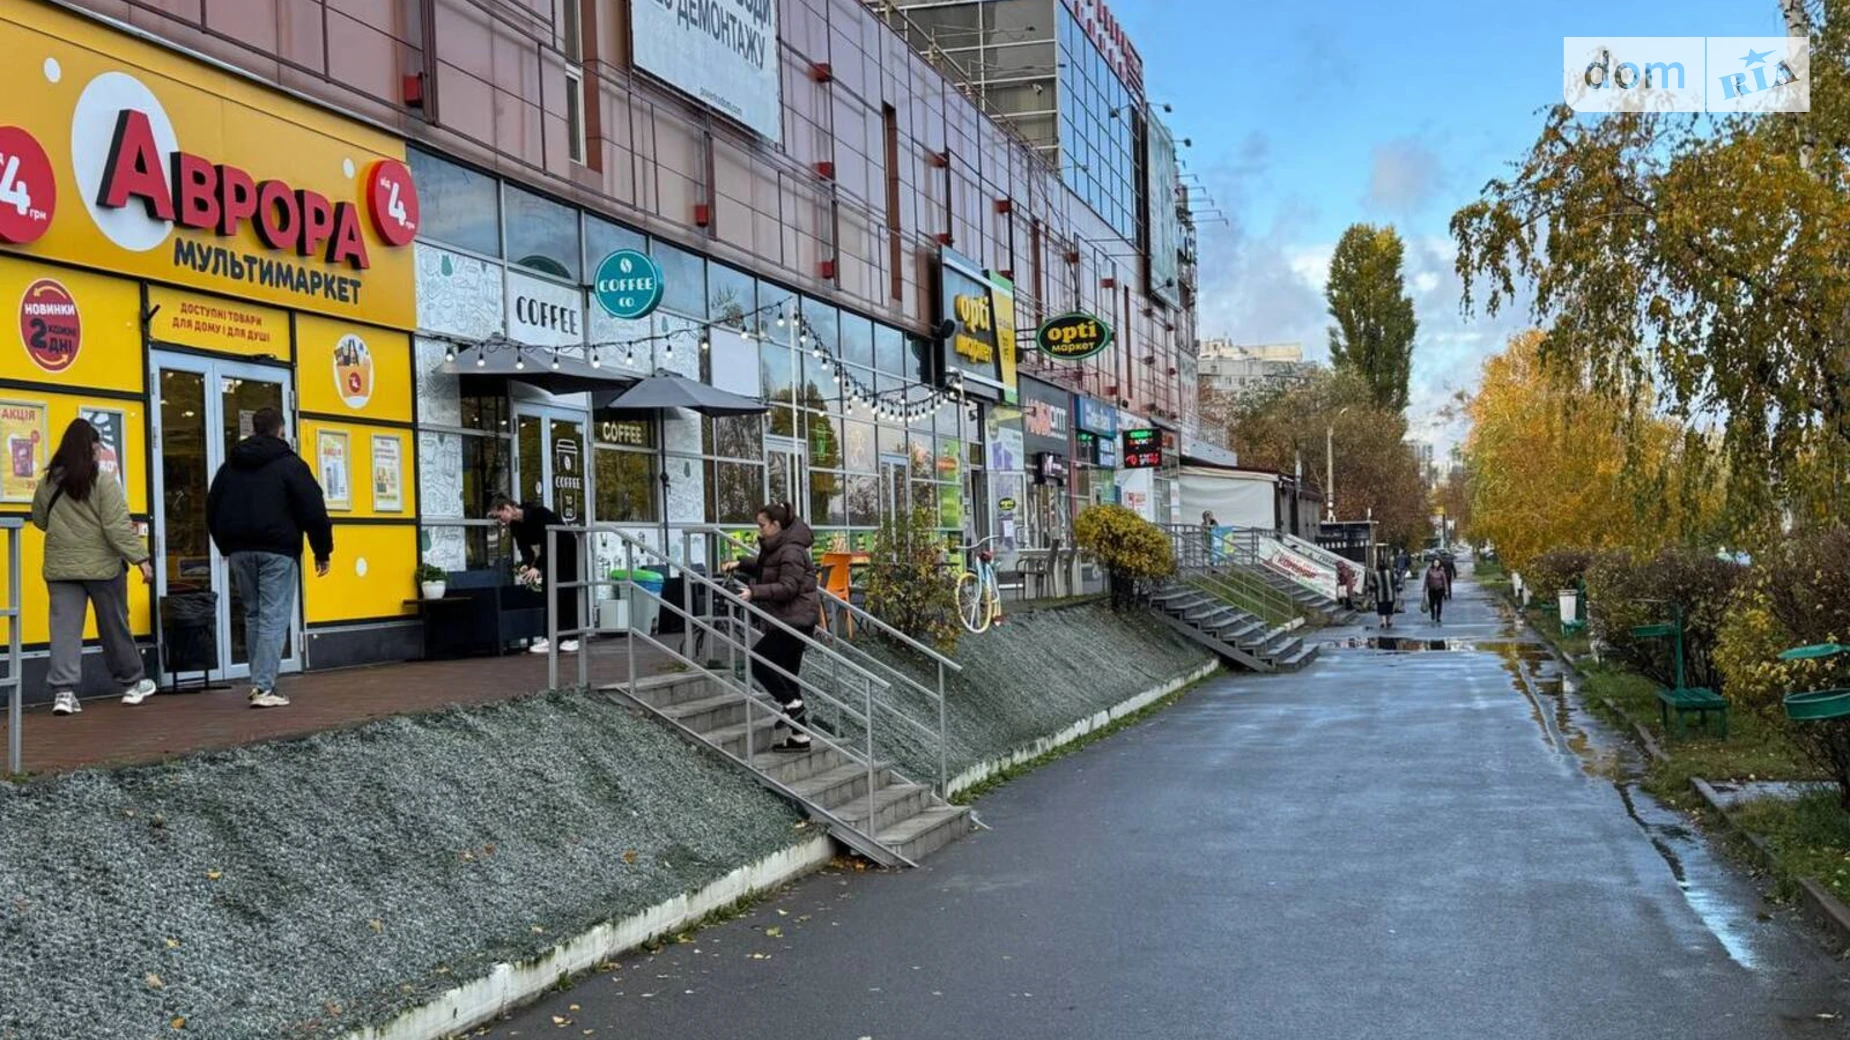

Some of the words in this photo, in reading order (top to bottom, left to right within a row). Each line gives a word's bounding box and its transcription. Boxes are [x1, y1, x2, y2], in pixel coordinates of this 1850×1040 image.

[678, 0, 765, 70] ДЕМОНТАЖУ
[0, 155, 31, 215] 4
[97, 109, 370, 269] АВРОРА
[29, 208, 47, 221] грн
[388, 182, 406, 226] 4
[174, 237, 362, 304] МУЛЬТИМАРКЕТ
[599, 277, 654, 293] COFFEE
[24, 303, 76, 316] НОВИНКИ
[618, 297, 635, 307] CO
[180, 302, 227, 321] ДОСТУПНІ
[228, 310, 262, 326] ТОВАРИ
[516, 296, 578, 336] COFFEE
[30, 318, 47, 349] 2
[172, 317, 193, 330] ДЛЯ
[194, 320, 221, 334] ДОМУ
[227, 327, 246, 339] ДЛЯ
[247, 330, 270, 342] ДУШІ
[1047, 321, 1097, 343] opti
[48, 337, 73, 354] ДНІ
[1051, 341, 1095, 354] маркет
[1, 407, 36, 421] АКЦІЯ
[602, 421, 642, 444] COFFEE
